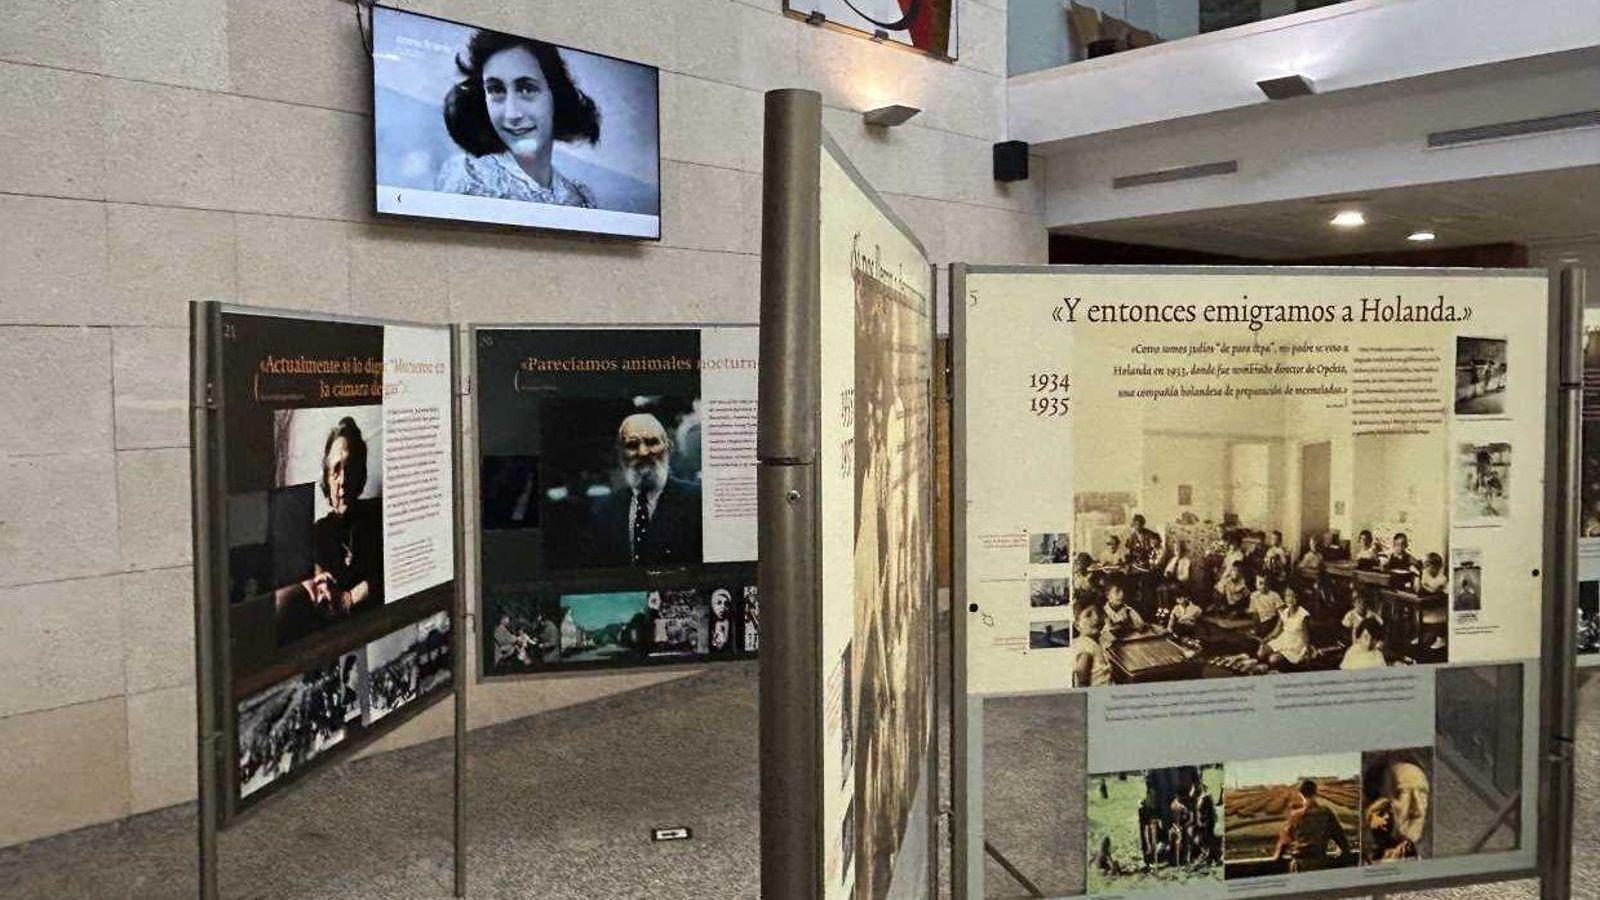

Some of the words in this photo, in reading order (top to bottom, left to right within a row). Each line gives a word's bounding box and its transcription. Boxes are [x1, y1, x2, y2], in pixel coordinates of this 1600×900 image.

[1052, 297, 1082, 322] «Y
[1087, 303, 1196, 322] entonces
[1204, 295, 1335, 331] emigramos
[1341, 305, 1354, 322] a
[1359, 296, 1472, 322] Holanda.»
[622, 356, 692, 370] animales
[1114, 364, 1152, 376] Holanda
[1190, 364, 1215, 374] donde
[1029, 373, 1070, 393] 1934
[1030, 397, 1070, 417] 1935
